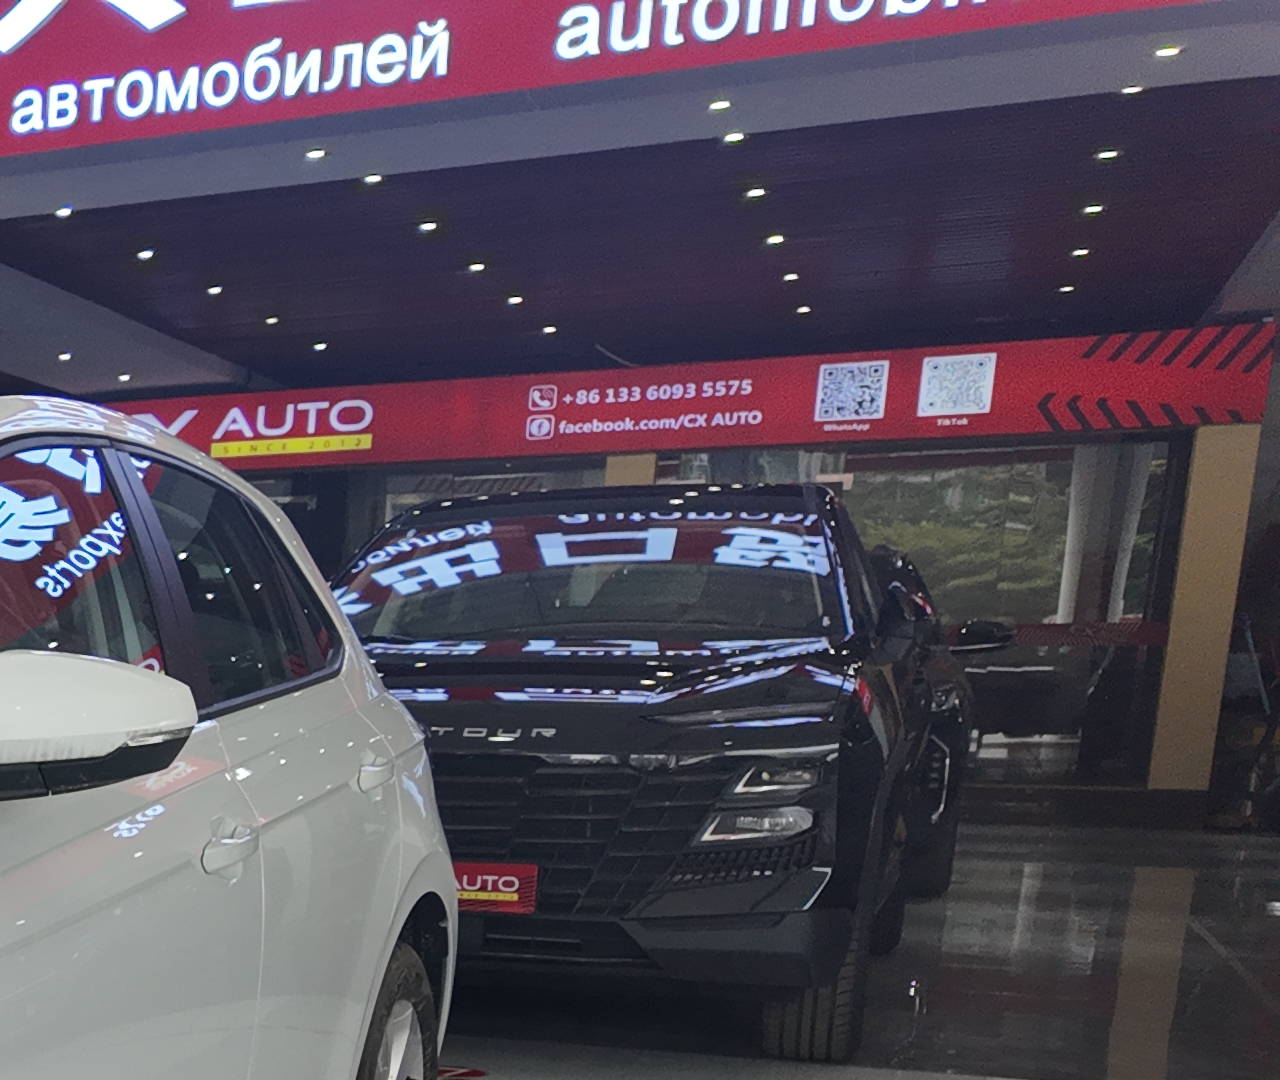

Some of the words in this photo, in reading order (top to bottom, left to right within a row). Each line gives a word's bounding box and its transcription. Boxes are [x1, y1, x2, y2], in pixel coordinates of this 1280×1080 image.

[11, 18, 451, 136] автомобилей
[562, 388, 601, 405] +86
[605, 387, 642, 403] 133
[646, 382, 697, 401] 6093
[701, 378, 754, 397] 5575
[212, 399, 374, 440] AUTO
[558, 412, 708, 435] facebook.com/CX
[711, 409, 764, 427] AUTO
[223, 442, 288, 455] SINCE
[308, 437, 362, 450] 2012
